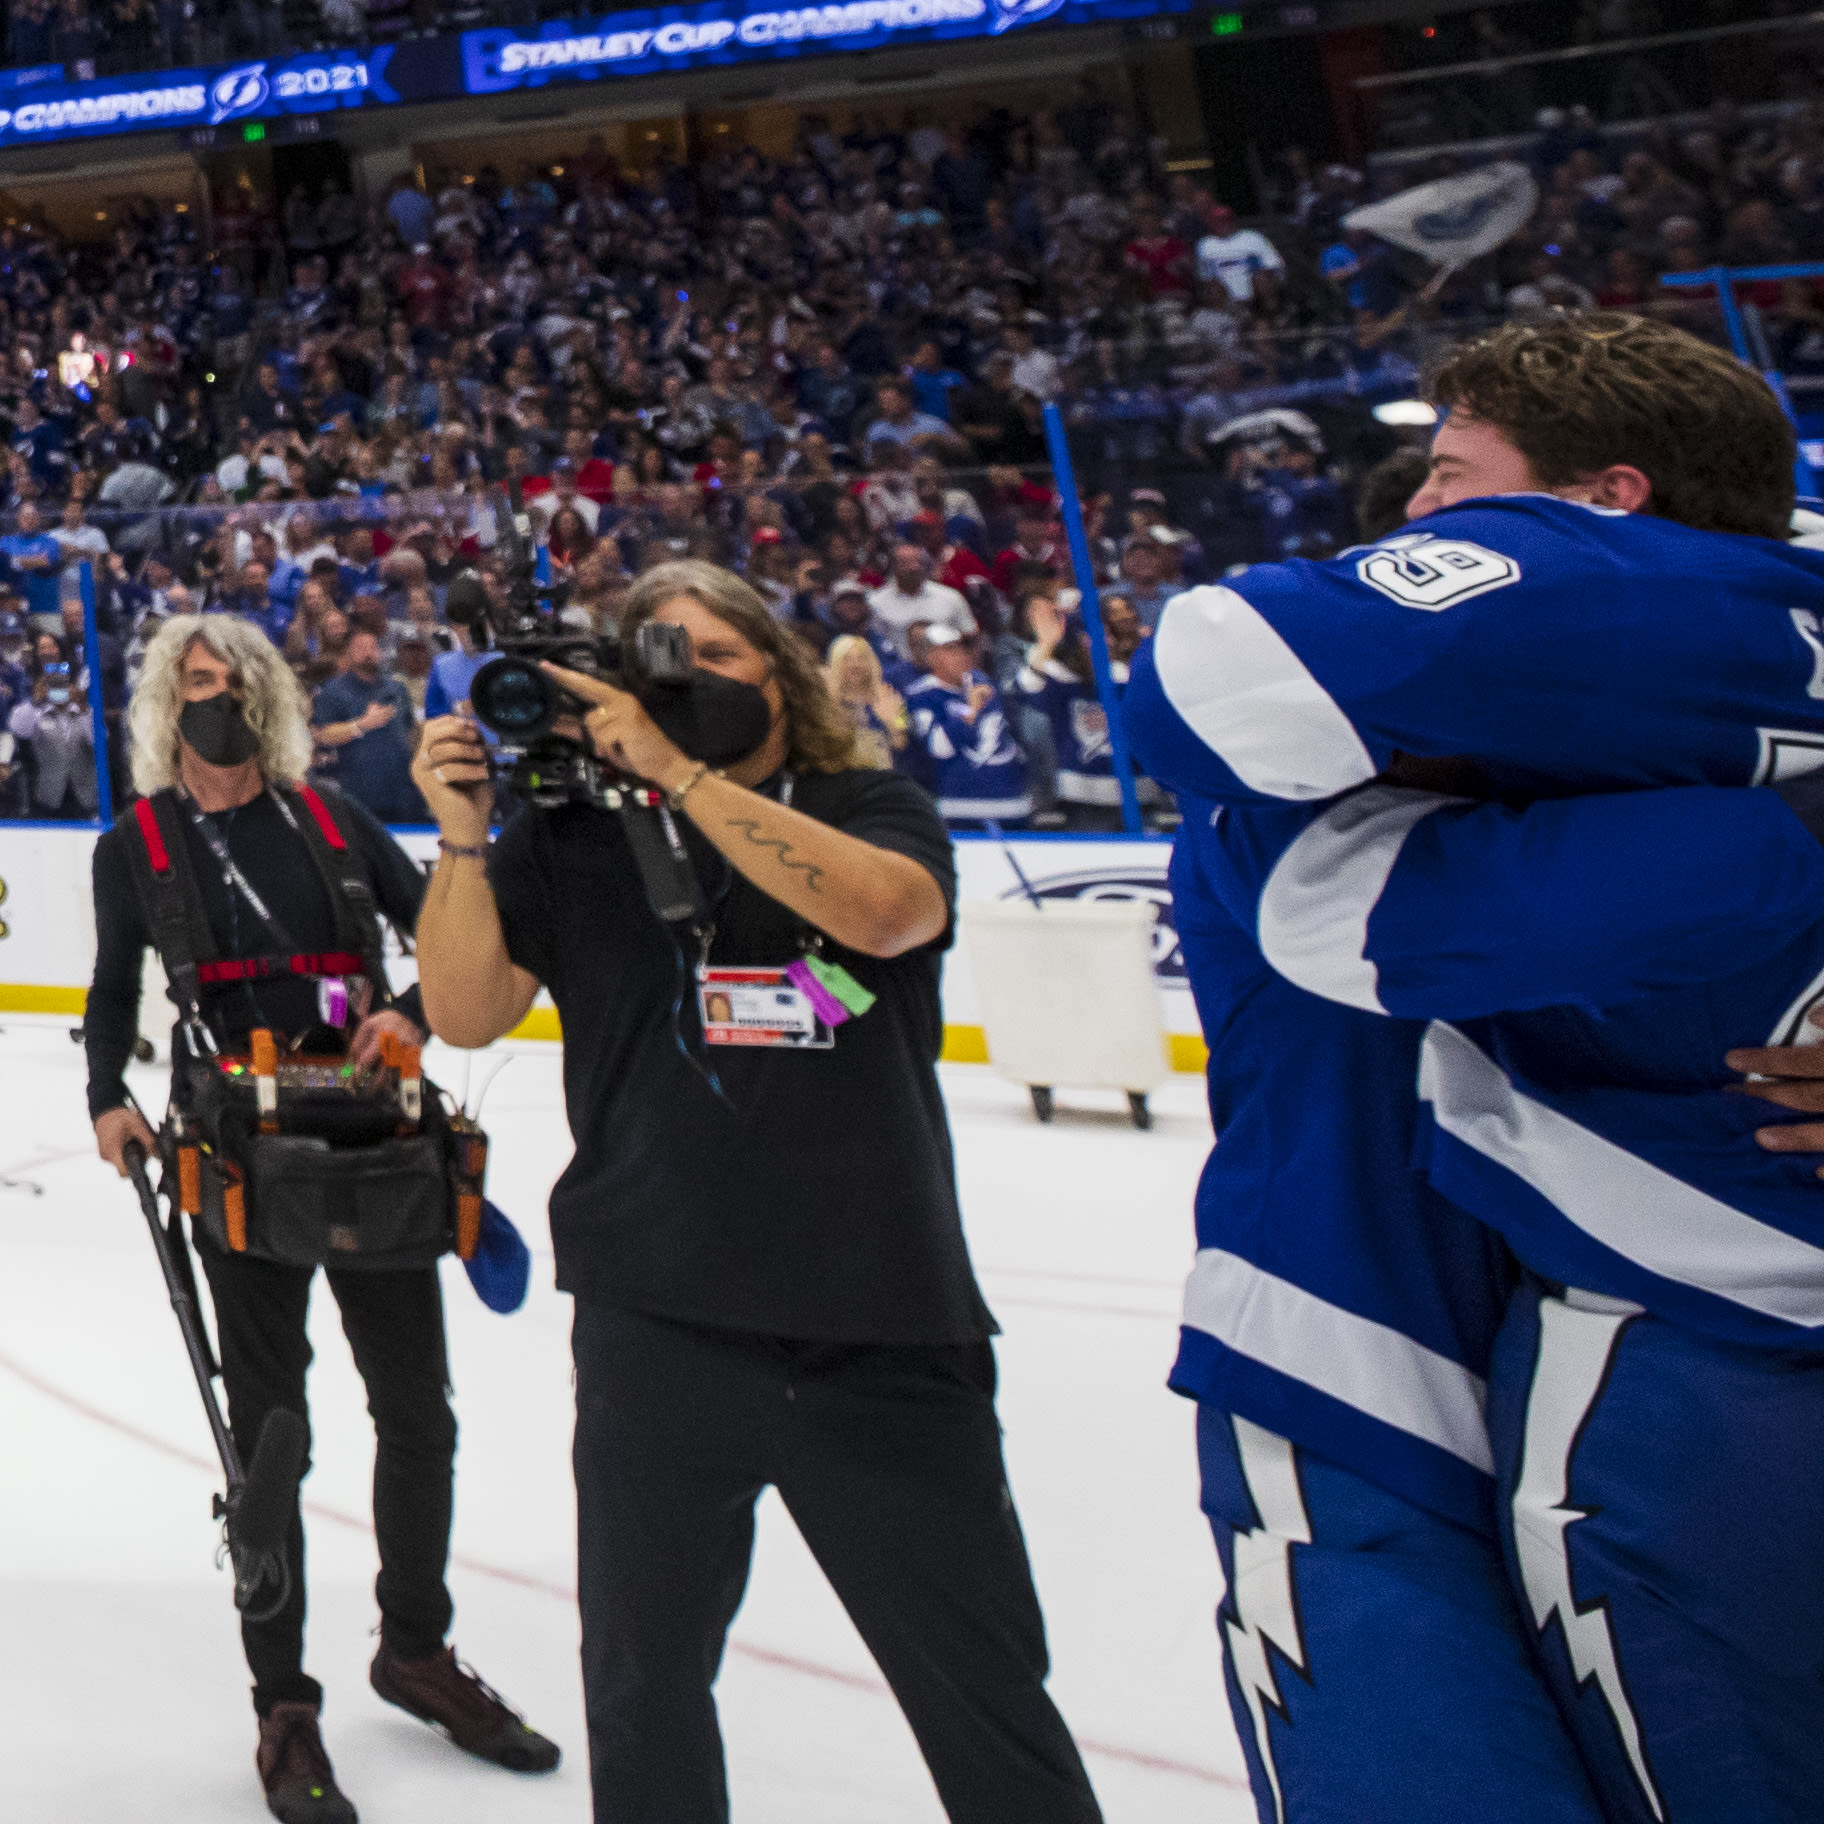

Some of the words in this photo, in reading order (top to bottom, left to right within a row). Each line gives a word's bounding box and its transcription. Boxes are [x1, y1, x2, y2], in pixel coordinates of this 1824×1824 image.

[499, 31, 654, 73] STANLEY
[654, 19, 735, 56] CUP
[14, 84, 207, 131] CHAMPIONS
[274, 64, 369, 97] 2021
